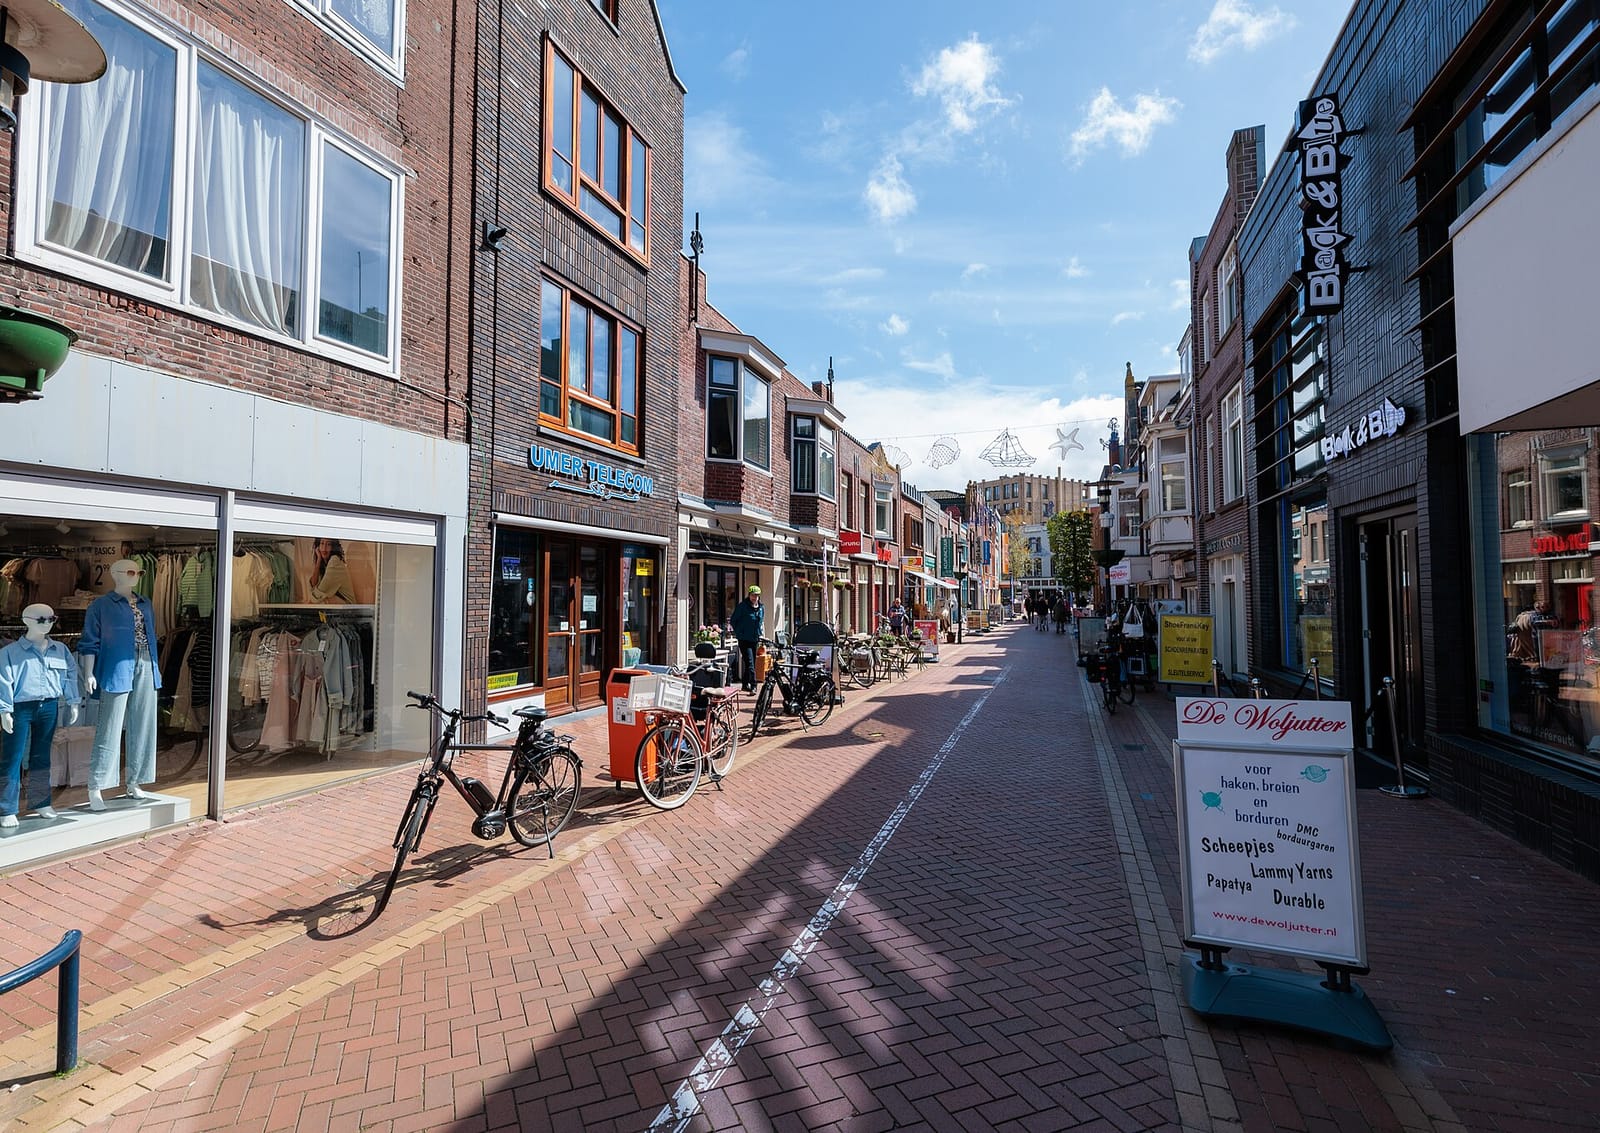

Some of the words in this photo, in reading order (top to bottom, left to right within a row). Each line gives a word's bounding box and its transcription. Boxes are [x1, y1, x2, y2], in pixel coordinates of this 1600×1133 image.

[1303, 98, 1338, 177] Blue
[1305, 181, 1338, 209] &
[1306, 211, 1341, 306] Black
[1357, 416, 1368, 446] &
[530, 444, 583, 478] UMER
[587, 459, 654, 496] TELECOM
[95, 546, 116, 555] BASICS
[1181, 700, 1228, 725] De
[1234, 702, 1347, 741] Woljutter
[1245, 764, 1272, 776] voor
[1259, 778, 1300, 794] breien
[1254, 798, 1268, 808] en
[1235, 809, 1289, 827] borduren
[1297, 823, 1319, 837] DMC
[1202, 837, 1275, 857] Scheepjes
[1276, 829, 1335, 853] borduurgaren
[1250, 862, 1294, 883] Lammy
[1296, 862, 1333, 880] Yarns
[1207, 874, 1252, 895] Papatya
[1273, 889, 1325, 910] Durable
[1213, 911, 1337, 937] www.dewoljutter.nl
